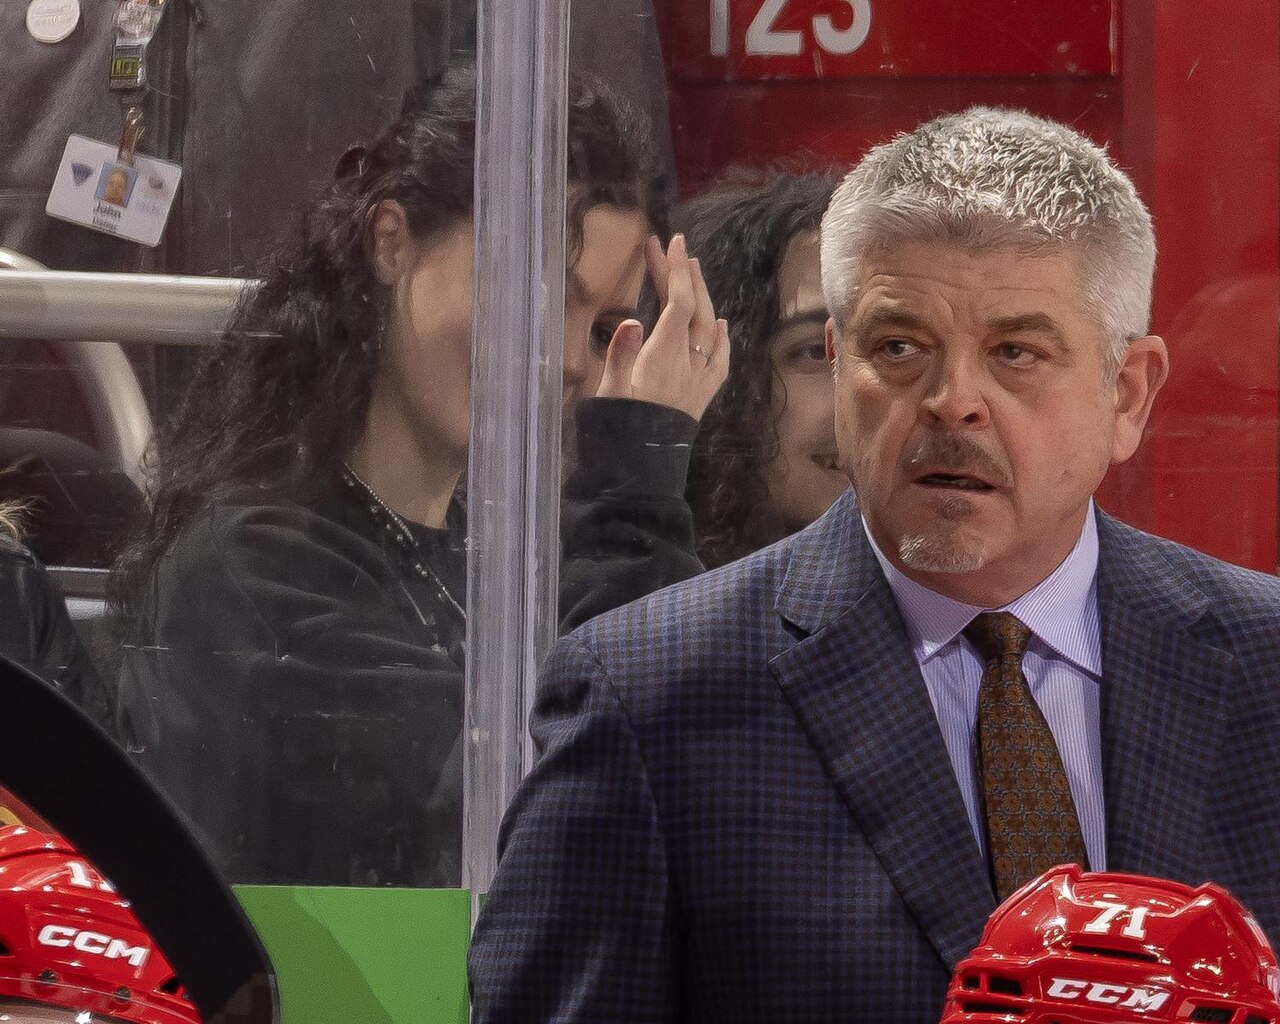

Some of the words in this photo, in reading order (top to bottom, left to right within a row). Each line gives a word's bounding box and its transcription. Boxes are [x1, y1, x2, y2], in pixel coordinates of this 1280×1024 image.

[710, 0, 872, 56] 123
[1083, 900, 1150, 940] 71
[38, 924, 149, 967] CCM
[1046, 977, 1170, 1012] CCM
